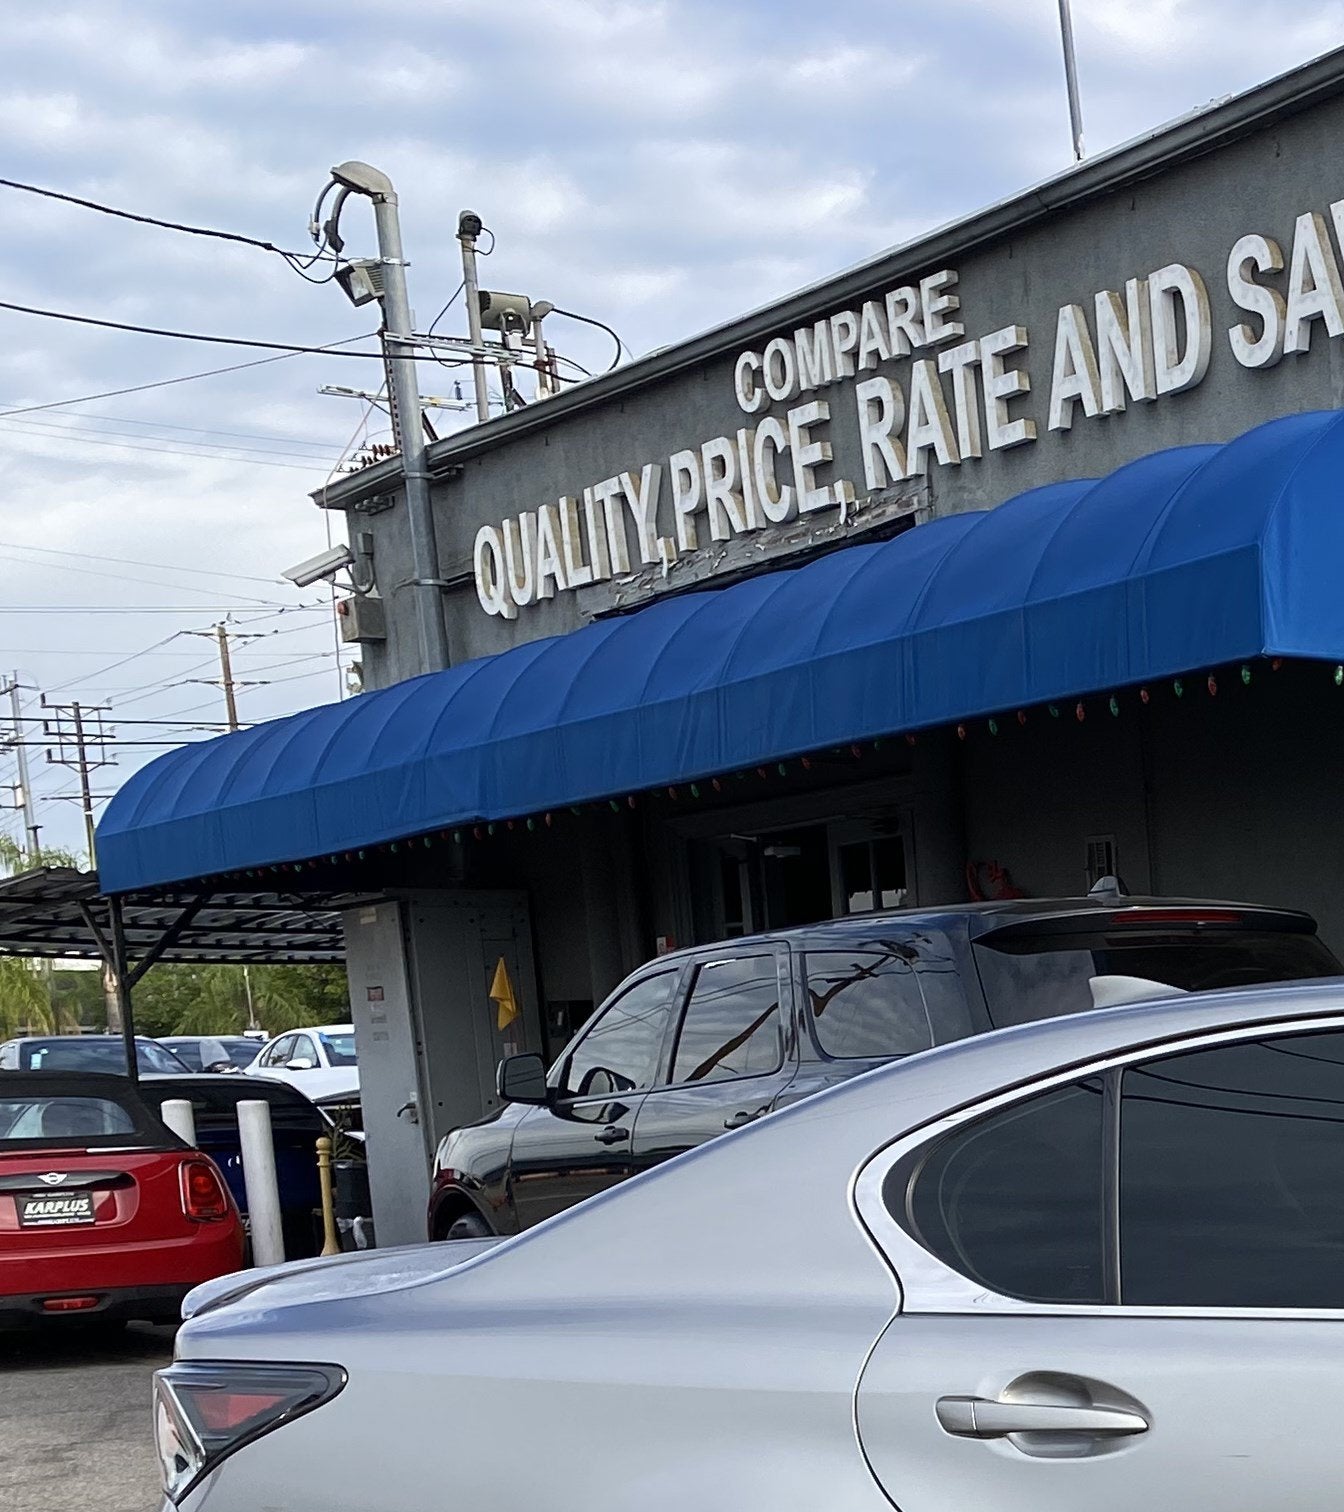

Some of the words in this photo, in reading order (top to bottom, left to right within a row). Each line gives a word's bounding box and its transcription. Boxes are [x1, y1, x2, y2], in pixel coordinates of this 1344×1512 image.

[735, 269, 966, 414] COMPARE
[855, 324, 1037, 490] RATE
[1047, 263, 1212, 431] AND
[24, 1198, 89, 1215] KARPLUS
